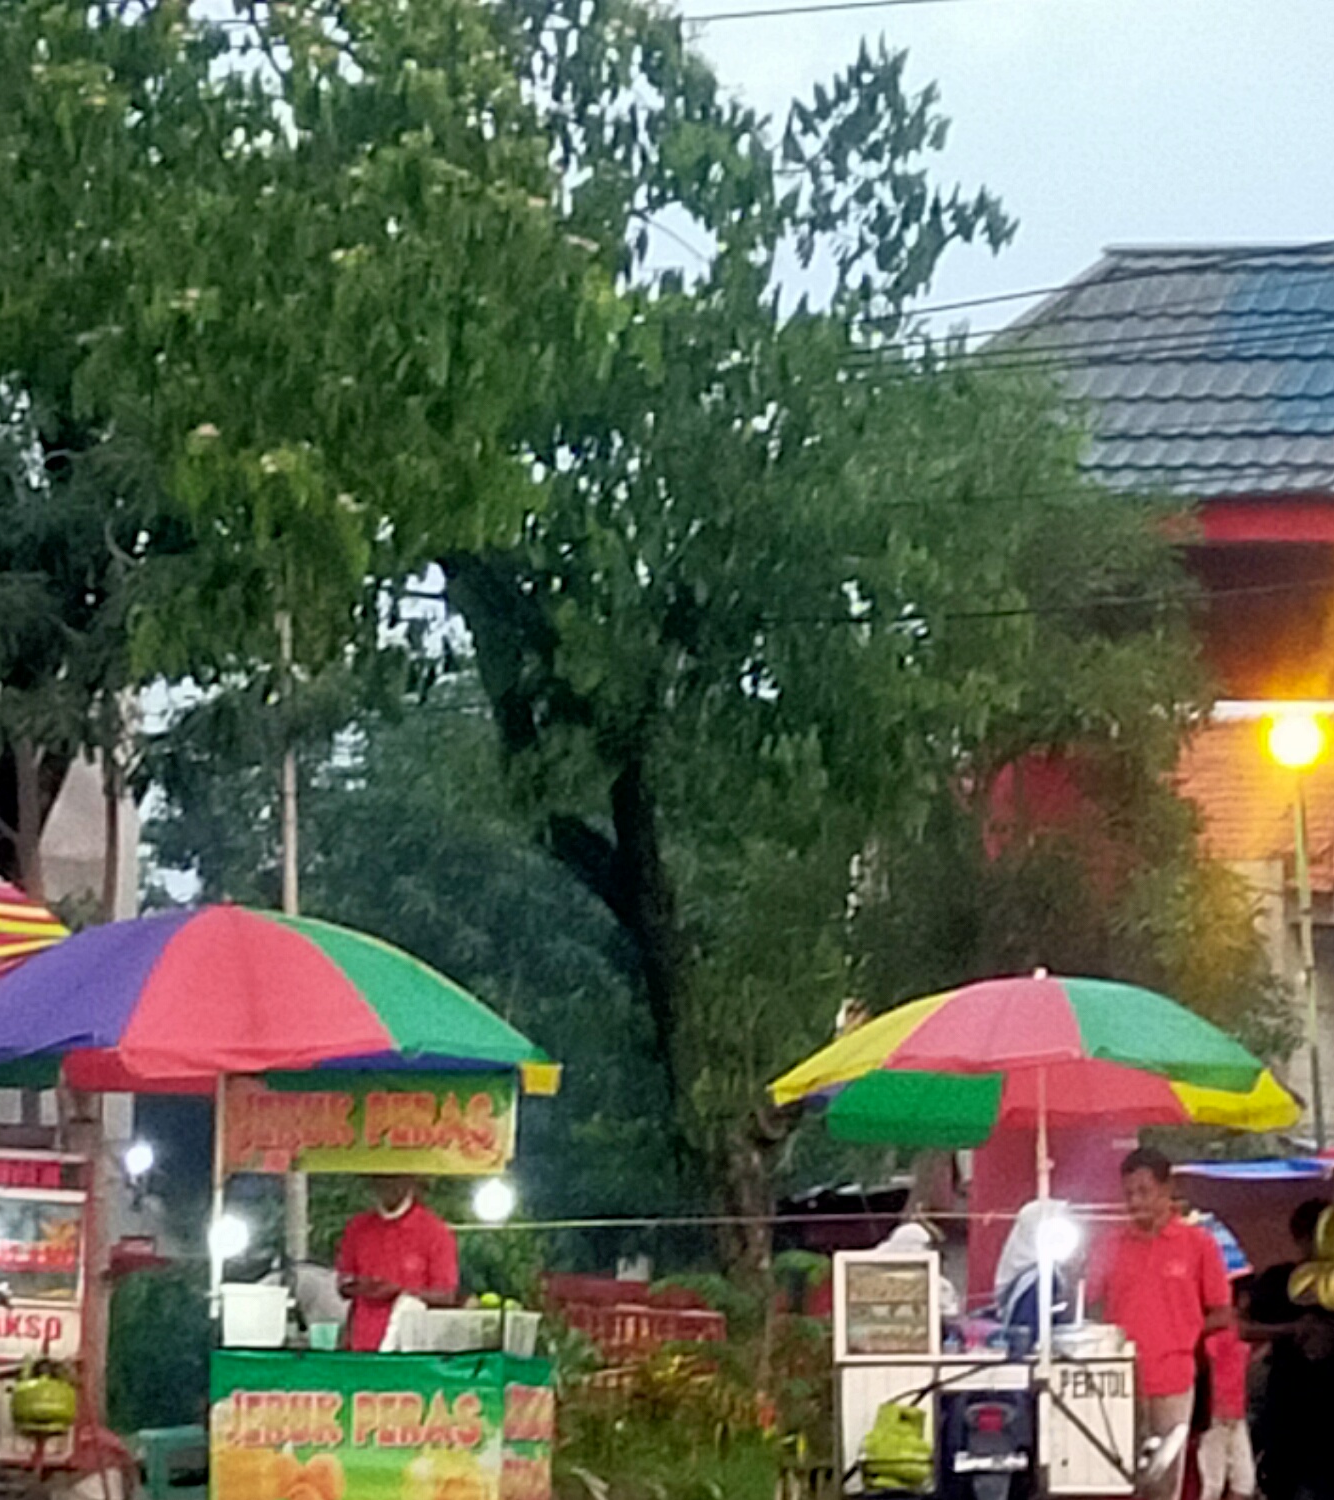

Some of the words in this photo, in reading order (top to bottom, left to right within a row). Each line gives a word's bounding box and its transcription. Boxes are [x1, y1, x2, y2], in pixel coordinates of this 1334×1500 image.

[237, 1091, 357, 1151] JERUK
[363, 1091, 497, 1151] PERAS
[227, 1389, 343, 1448] JERUK
[352, 1387, 483, 1448] PERAS
